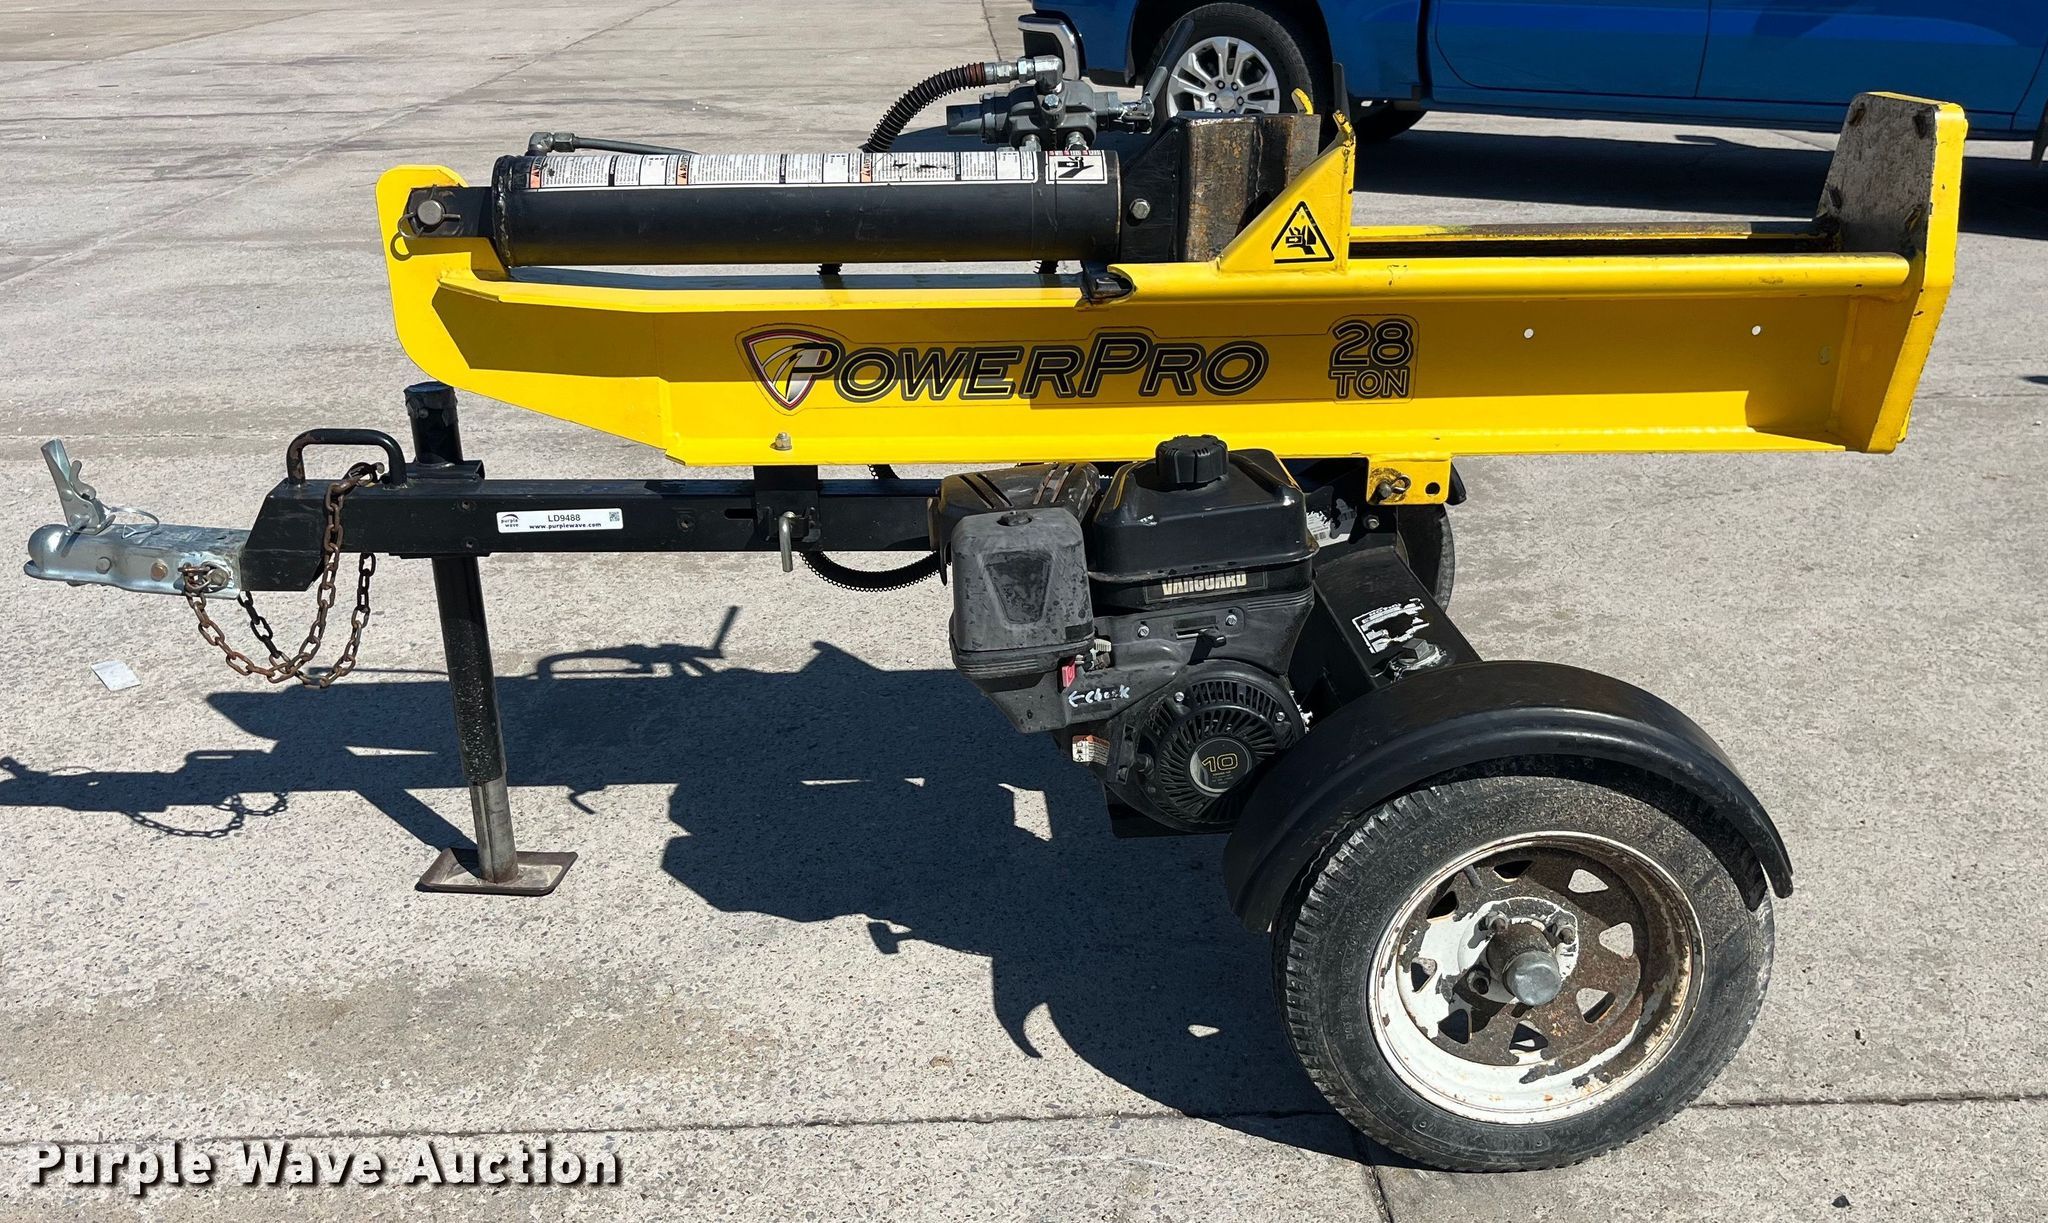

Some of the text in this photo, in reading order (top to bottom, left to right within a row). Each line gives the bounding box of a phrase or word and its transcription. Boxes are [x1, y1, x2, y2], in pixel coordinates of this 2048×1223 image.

[1330, 319, 1414, 367] 28
[1328, 366, 1409, 398] TON
[547, 514, 581, 522] LD9488
[1161, 574, 1247, 596] VANGUARD
[1201, 752, 1239, 773] 10
